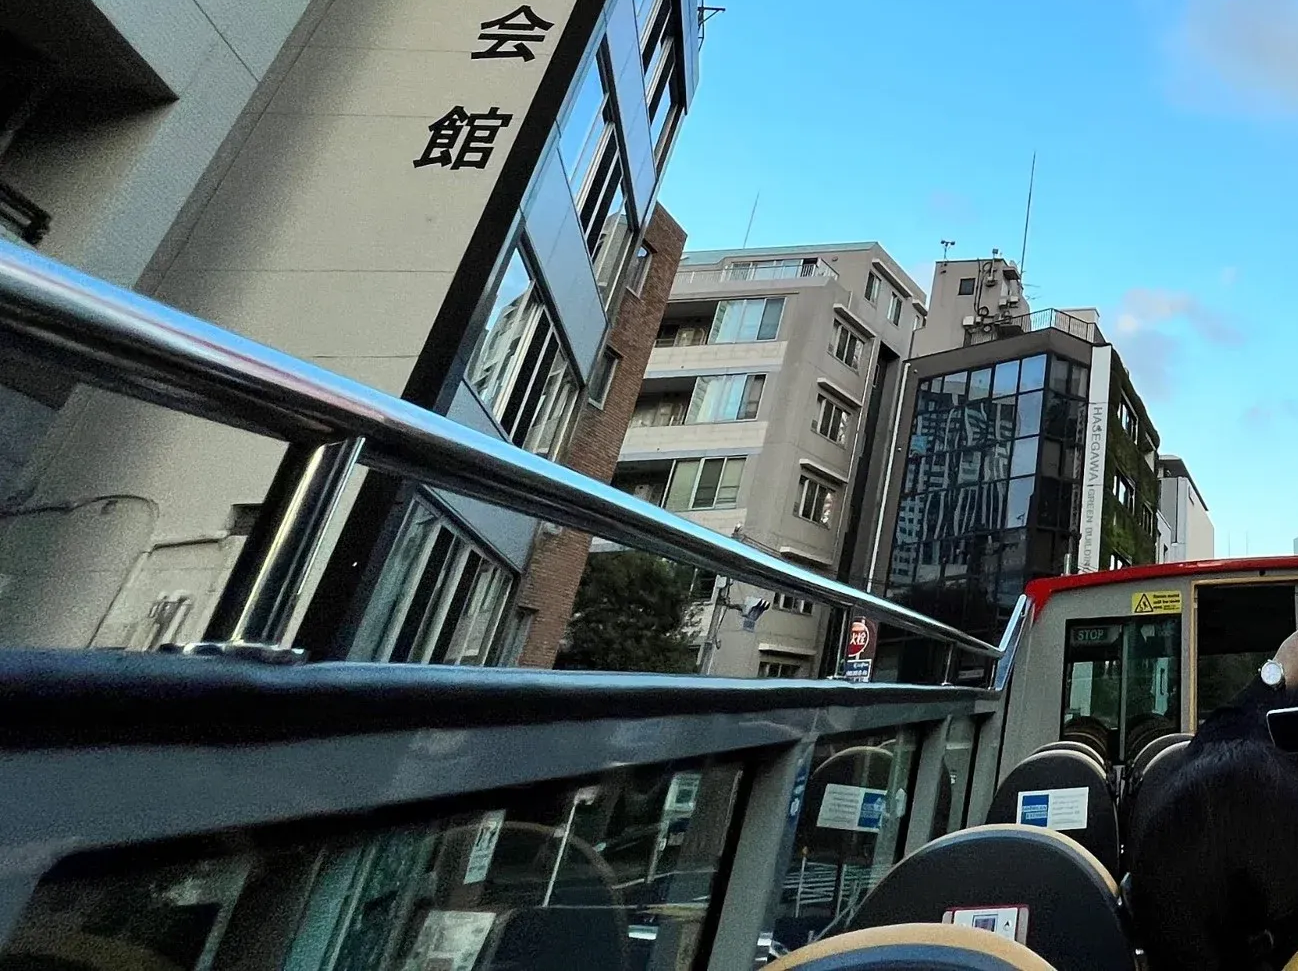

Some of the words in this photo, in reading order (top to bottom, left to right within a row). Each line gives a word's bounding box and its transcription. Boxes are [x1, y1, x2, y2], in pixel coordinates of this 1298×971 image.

[1089, 406, 1103, 482] HASEGAWA
[1085, 488, 1096, 523] GREEN
[1083, 527, 1093, 572] BUILDIN
[849, 631, 867, 645] 火栓
[1077, 629, 1104, 641] STOP
